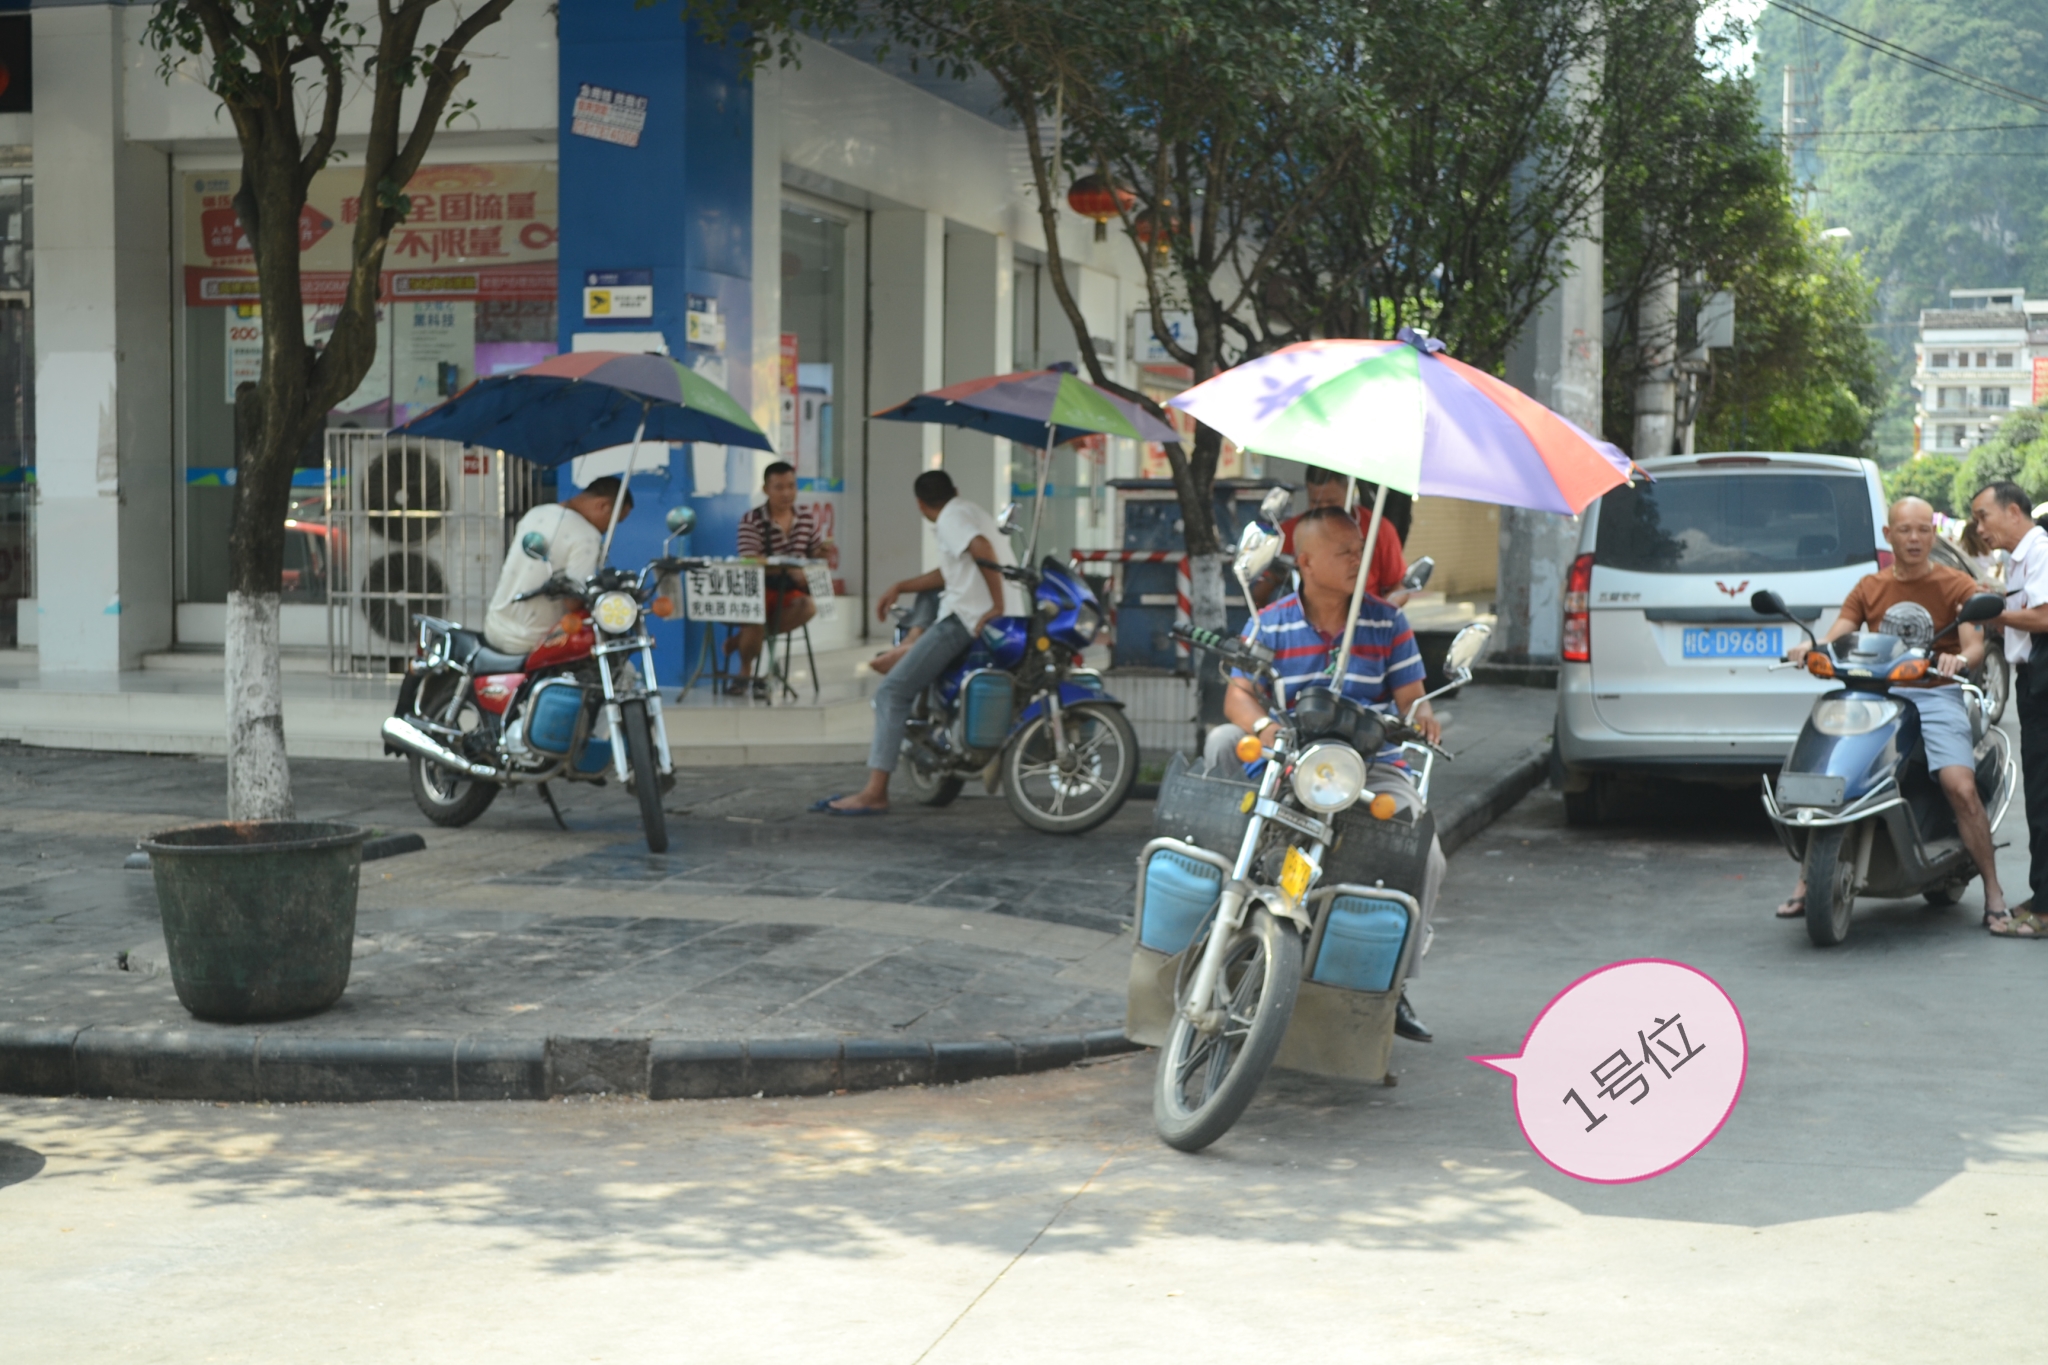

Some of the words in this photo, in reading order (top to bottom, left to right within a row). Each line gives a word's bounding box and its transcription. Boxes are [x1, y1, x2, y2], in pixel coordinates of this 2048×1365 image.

[393, 225, 509, 264] 不限量
[689, 567, 759, 597] 专业贴膜
